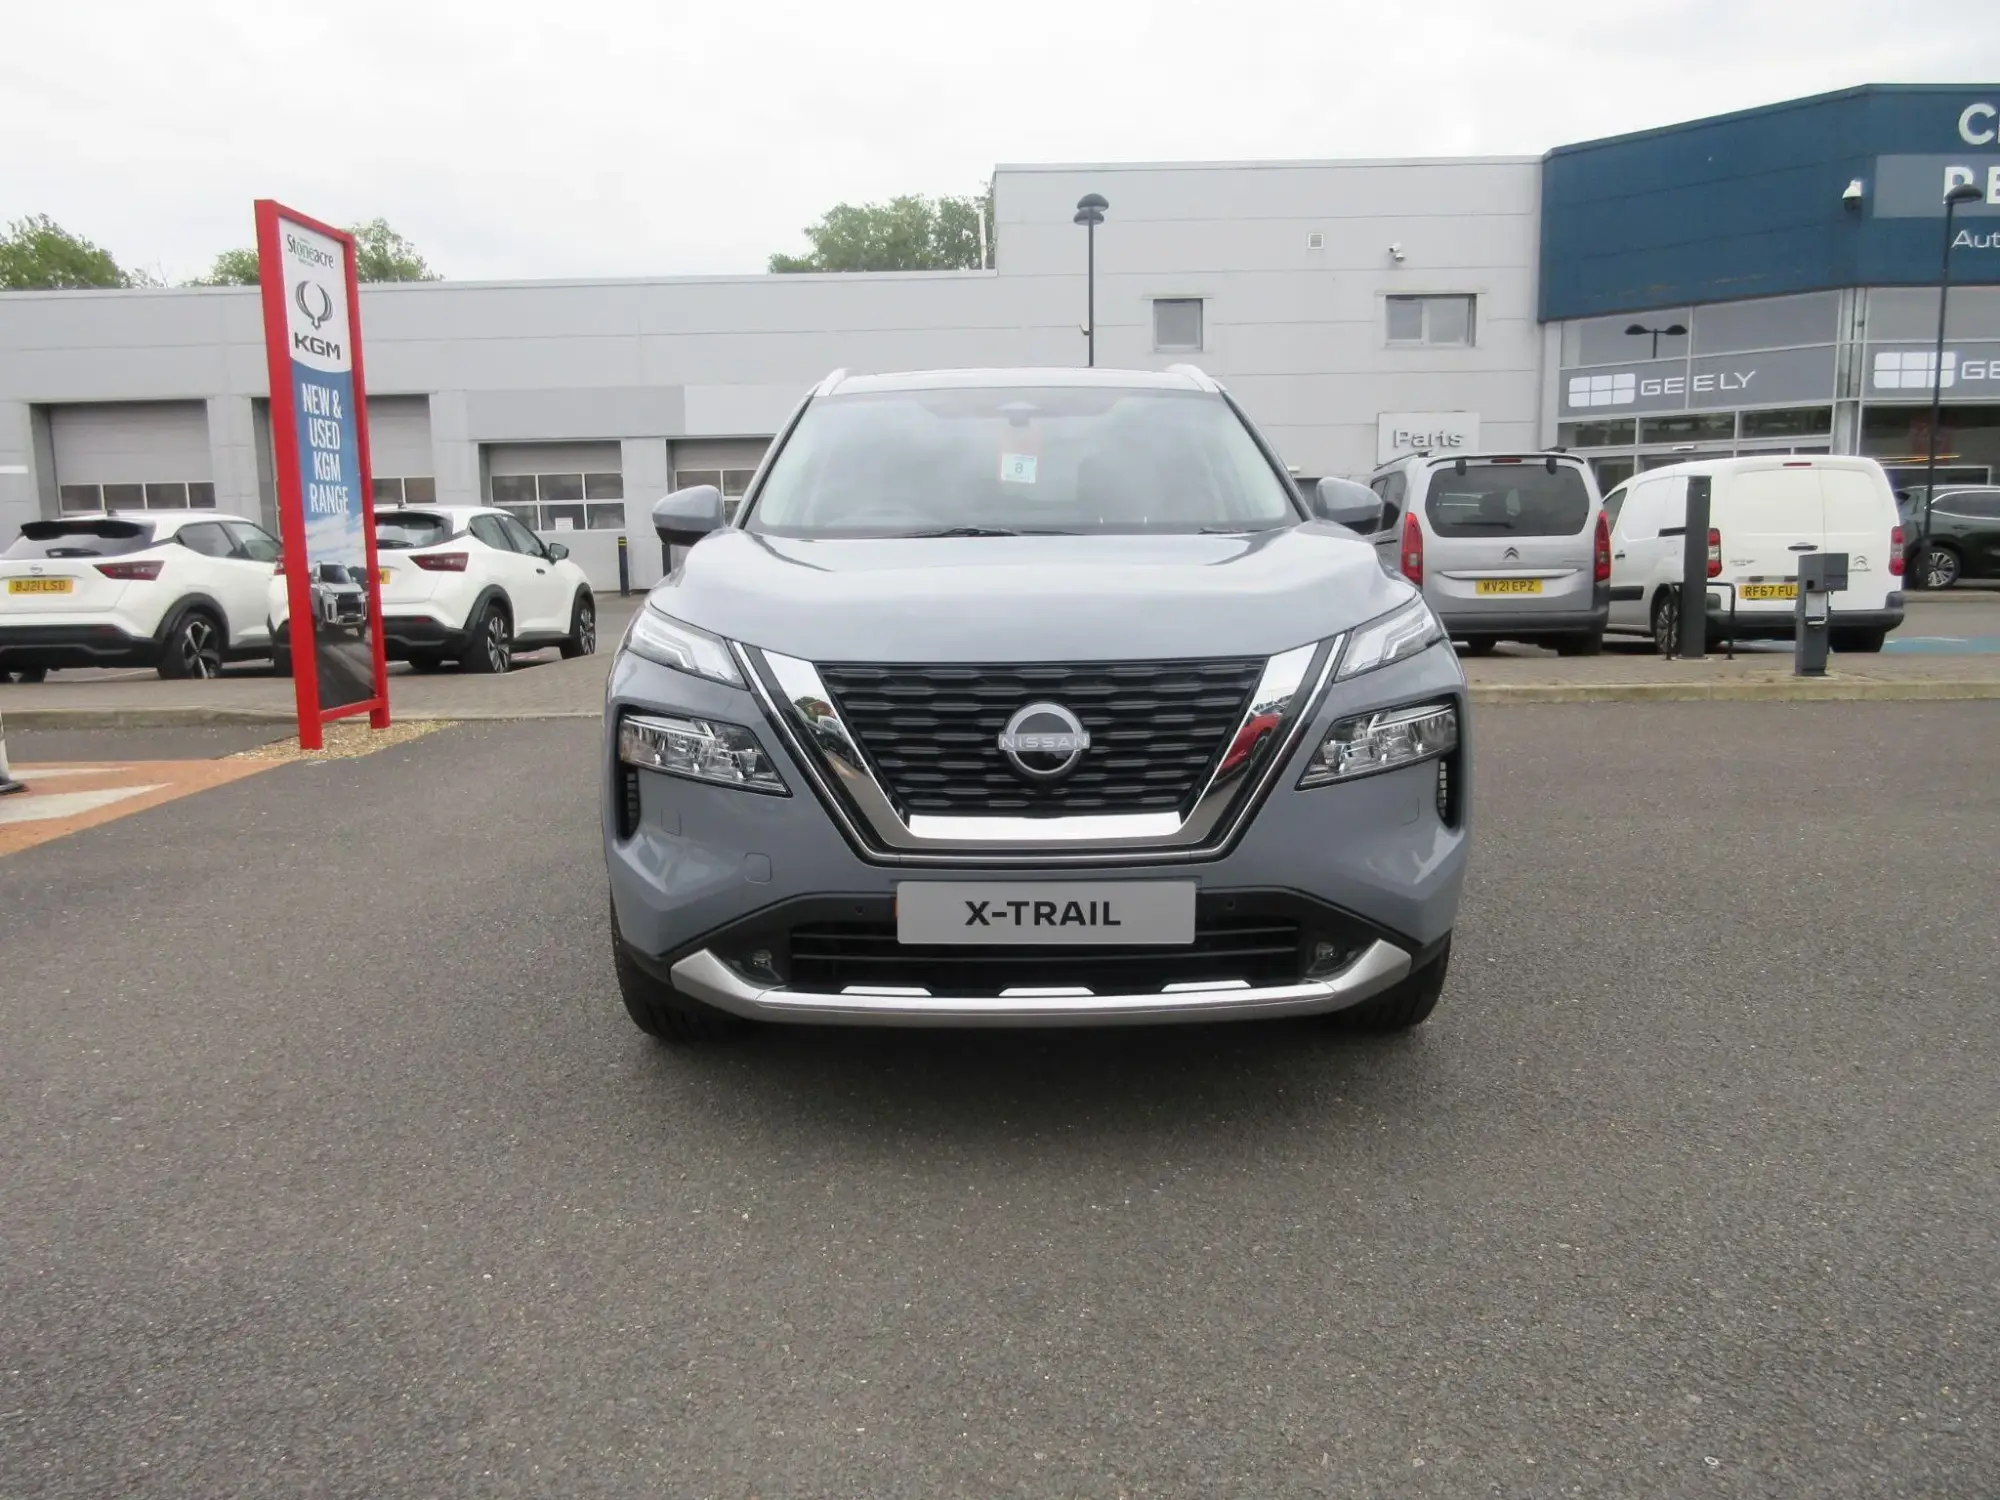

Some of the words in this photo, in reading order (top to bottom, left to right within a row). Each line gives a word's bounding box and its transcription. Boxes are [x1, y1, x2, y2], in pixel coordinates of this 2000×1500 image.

[286, 233, 335, 269] Stoneacre
[294, 331, 341, 361] KGM
[1640, 368, 1756, 396] GEELY
[301, 382, 330, 417] NEW
[332, 389, 342, 420] &
[308, 416, 340, 451] USED
[1392, 429, 1464, 449] Parts
[313, 450, 342, 483] KGM
[308, 482, 350, 515] RANGE
[1482, 580, 1509, 593] WV21
[1511, 580, 1535, 592] EPZ
[1744, 586, 1775, 597] RF67
[1777, 586, 1799, 597] FU
[1001, 736, 1088, 749] NISSAN
[964, 900, 1121, 926] X-TRAIL
